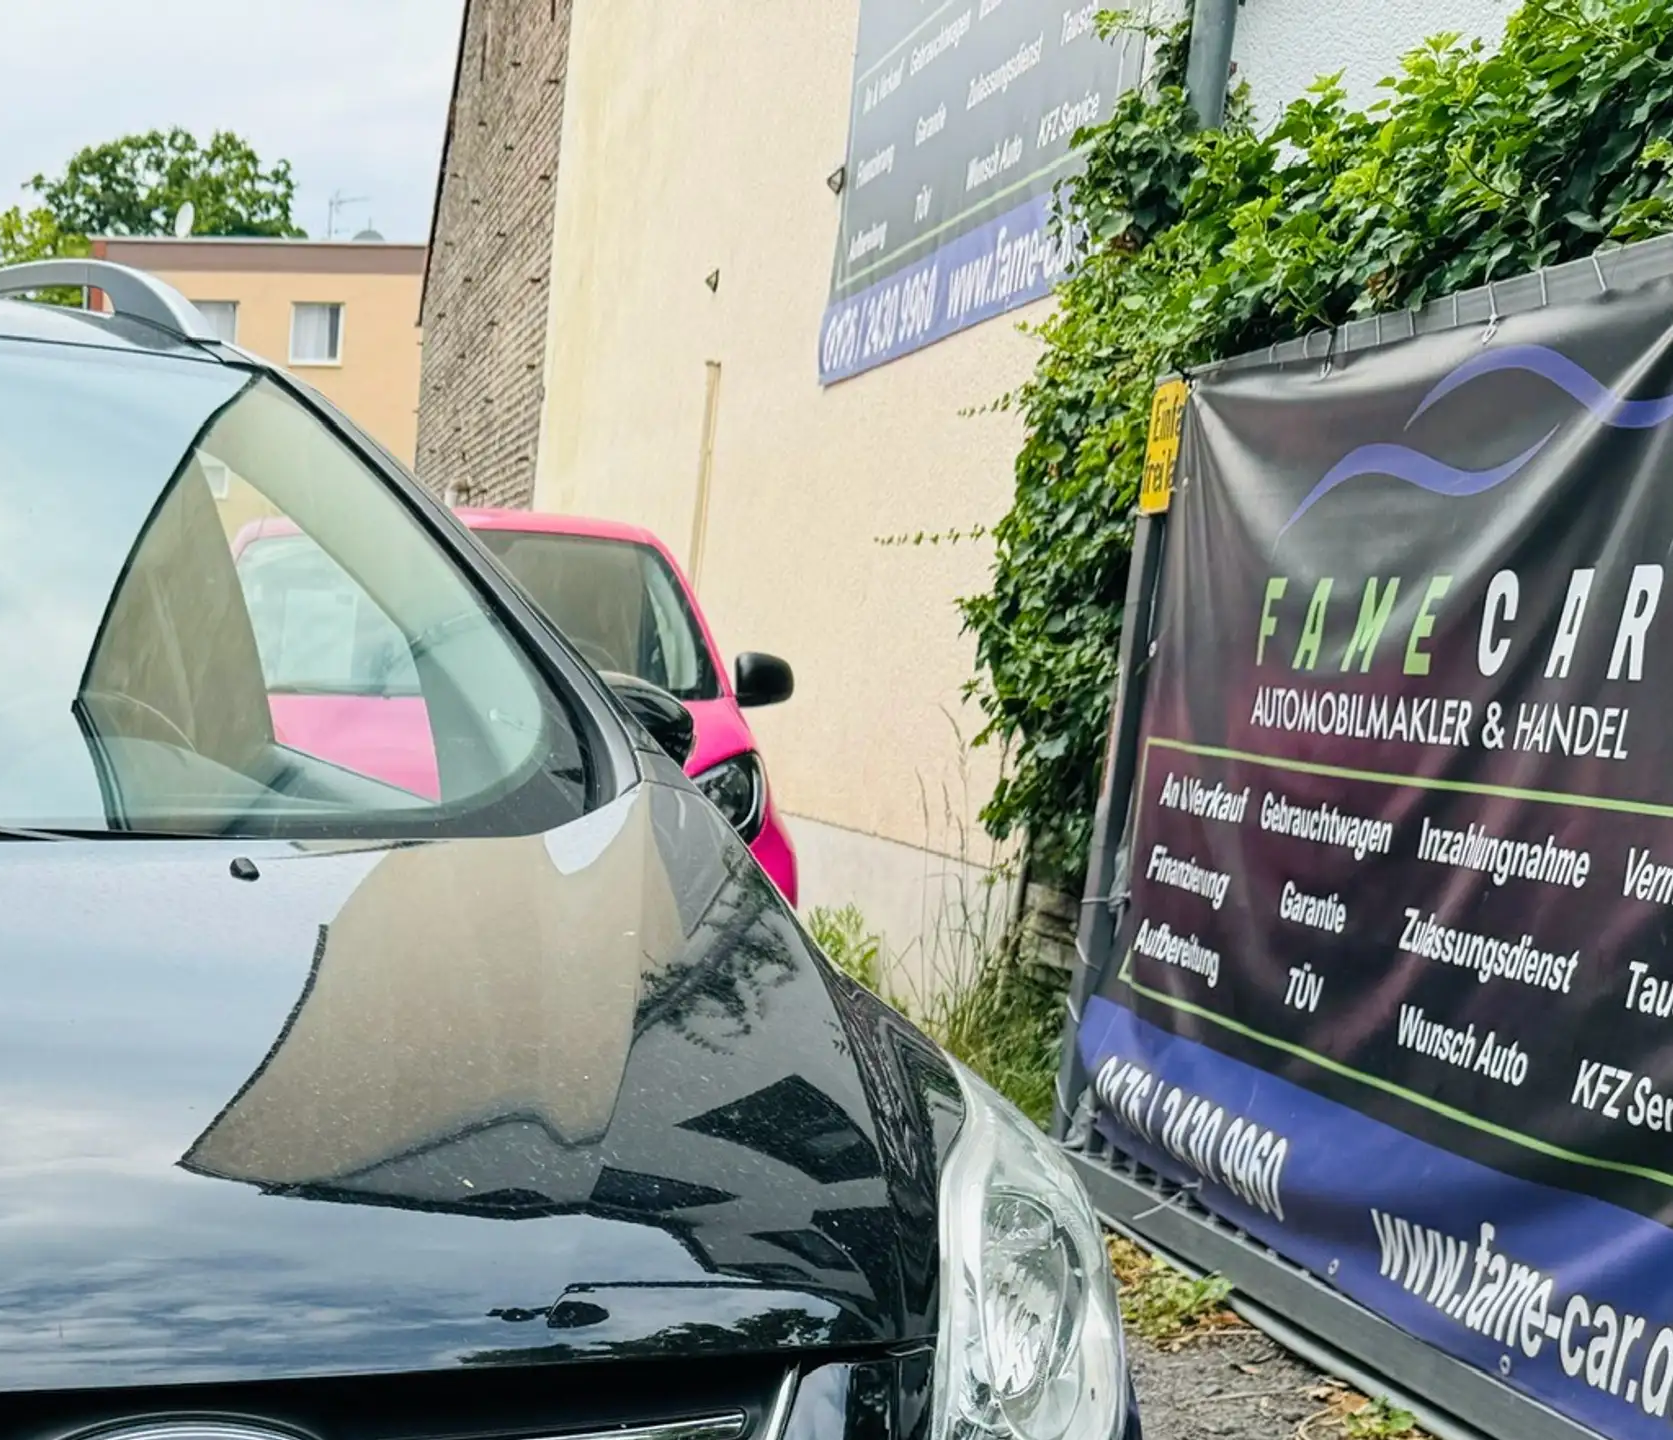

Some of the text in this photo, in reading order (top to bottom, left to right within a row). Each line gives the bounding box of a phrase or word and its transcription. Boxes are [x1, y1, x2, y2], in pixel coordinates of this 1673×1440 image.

[1058, 89, 1100, 137] Service
[1255, 563, 1664, 682] FAME CAR
[1250, 686, 1630, 761] AUTOMOBILMAKLER & HANDEL
[1158, 771, 1180, 809] An
[1188, 778, 1252, 824] Verkauf
[1260, 791, 1394, 861] Gebrauchtwagen
[1146, 844, 1232, 910] Finanzierung
[1417, 816, 1592, 888] Inzahlungnahme
[1279, 880, 1348, 934] Garantie
[1133, 918, 1221, 989] Aufbereitung
[1398, 907, 1580, 994] Zulassungsdienst
[1283, 962, 1325, 1013] TÜV
[1397, 1002, 1529, 1087] Wunsch Auto
[1570, 1058, 1634, 1120] KFZ
